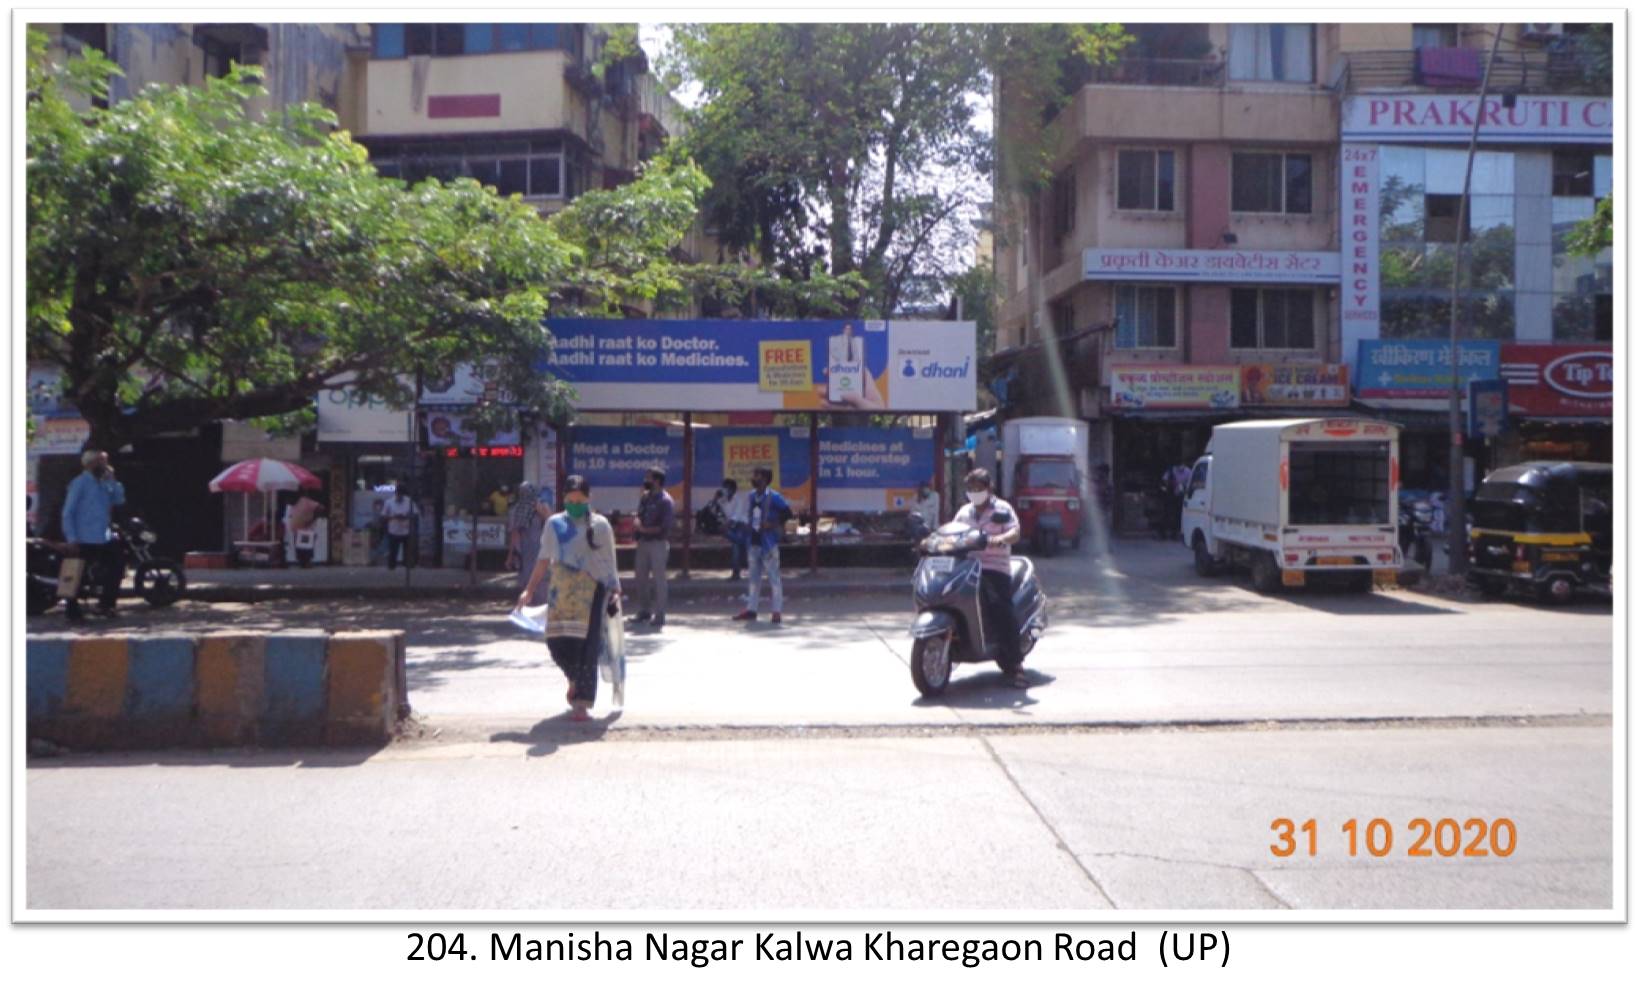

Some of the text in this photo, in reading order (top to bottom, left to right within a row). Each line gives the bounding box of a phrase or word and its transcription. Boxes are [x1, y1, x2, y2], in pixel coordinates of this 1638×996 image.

[1368, 98, 1612, 128] PRAKRUTI C
[1344, 149, 1377, 162] 24x7
[1352, 165, 1369, 307] EMERGENCY
[549, 335, 719, 350] Aadhi raat ko Doctor.
[548, 352, 749, 367] Aadhi raat ko Medicines.
[765, 348, 805, 364] FREE
[921, 356, 971, 378] dhani
[1563, 363, 1594, 386] Tip
[574, 442, 670, 455] Meet a Doctor
[730, 443, 773, 460] FREE
[819, 440, 904, 453] Medicines at
[573, 458, 586, 471] in
[588, 458, 605, 471] 10
[819, 453, 911, 466] your doorstep
[819, 466, 880, 479] in 1 hour.
